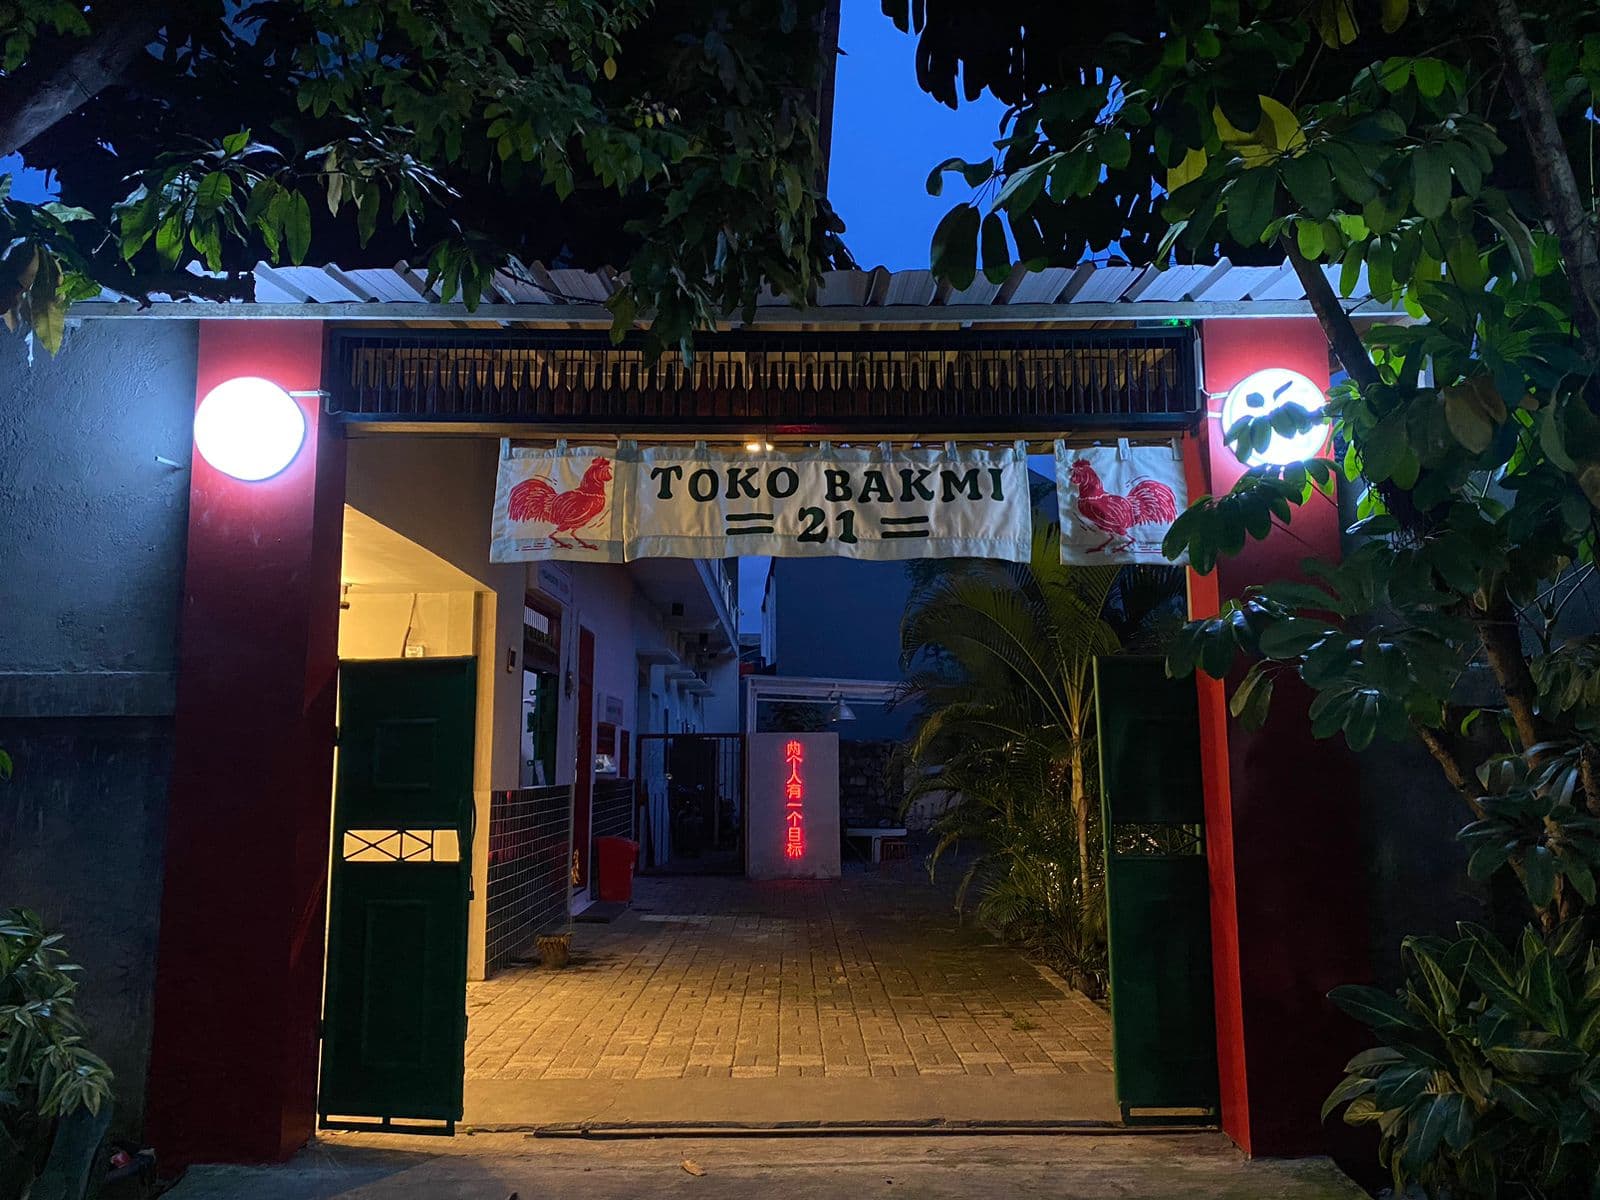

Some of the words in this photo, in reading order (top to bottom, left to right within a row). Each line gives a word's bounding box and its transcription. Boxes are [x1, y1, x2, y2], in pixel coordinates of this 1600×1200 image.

[651, 465, 799, 502] TOKO
[823, 466, 1004, 504] BAKMI
[796, 506, 859, 545] 21
[785, 740, 804, 858] 两个人有一个目标
